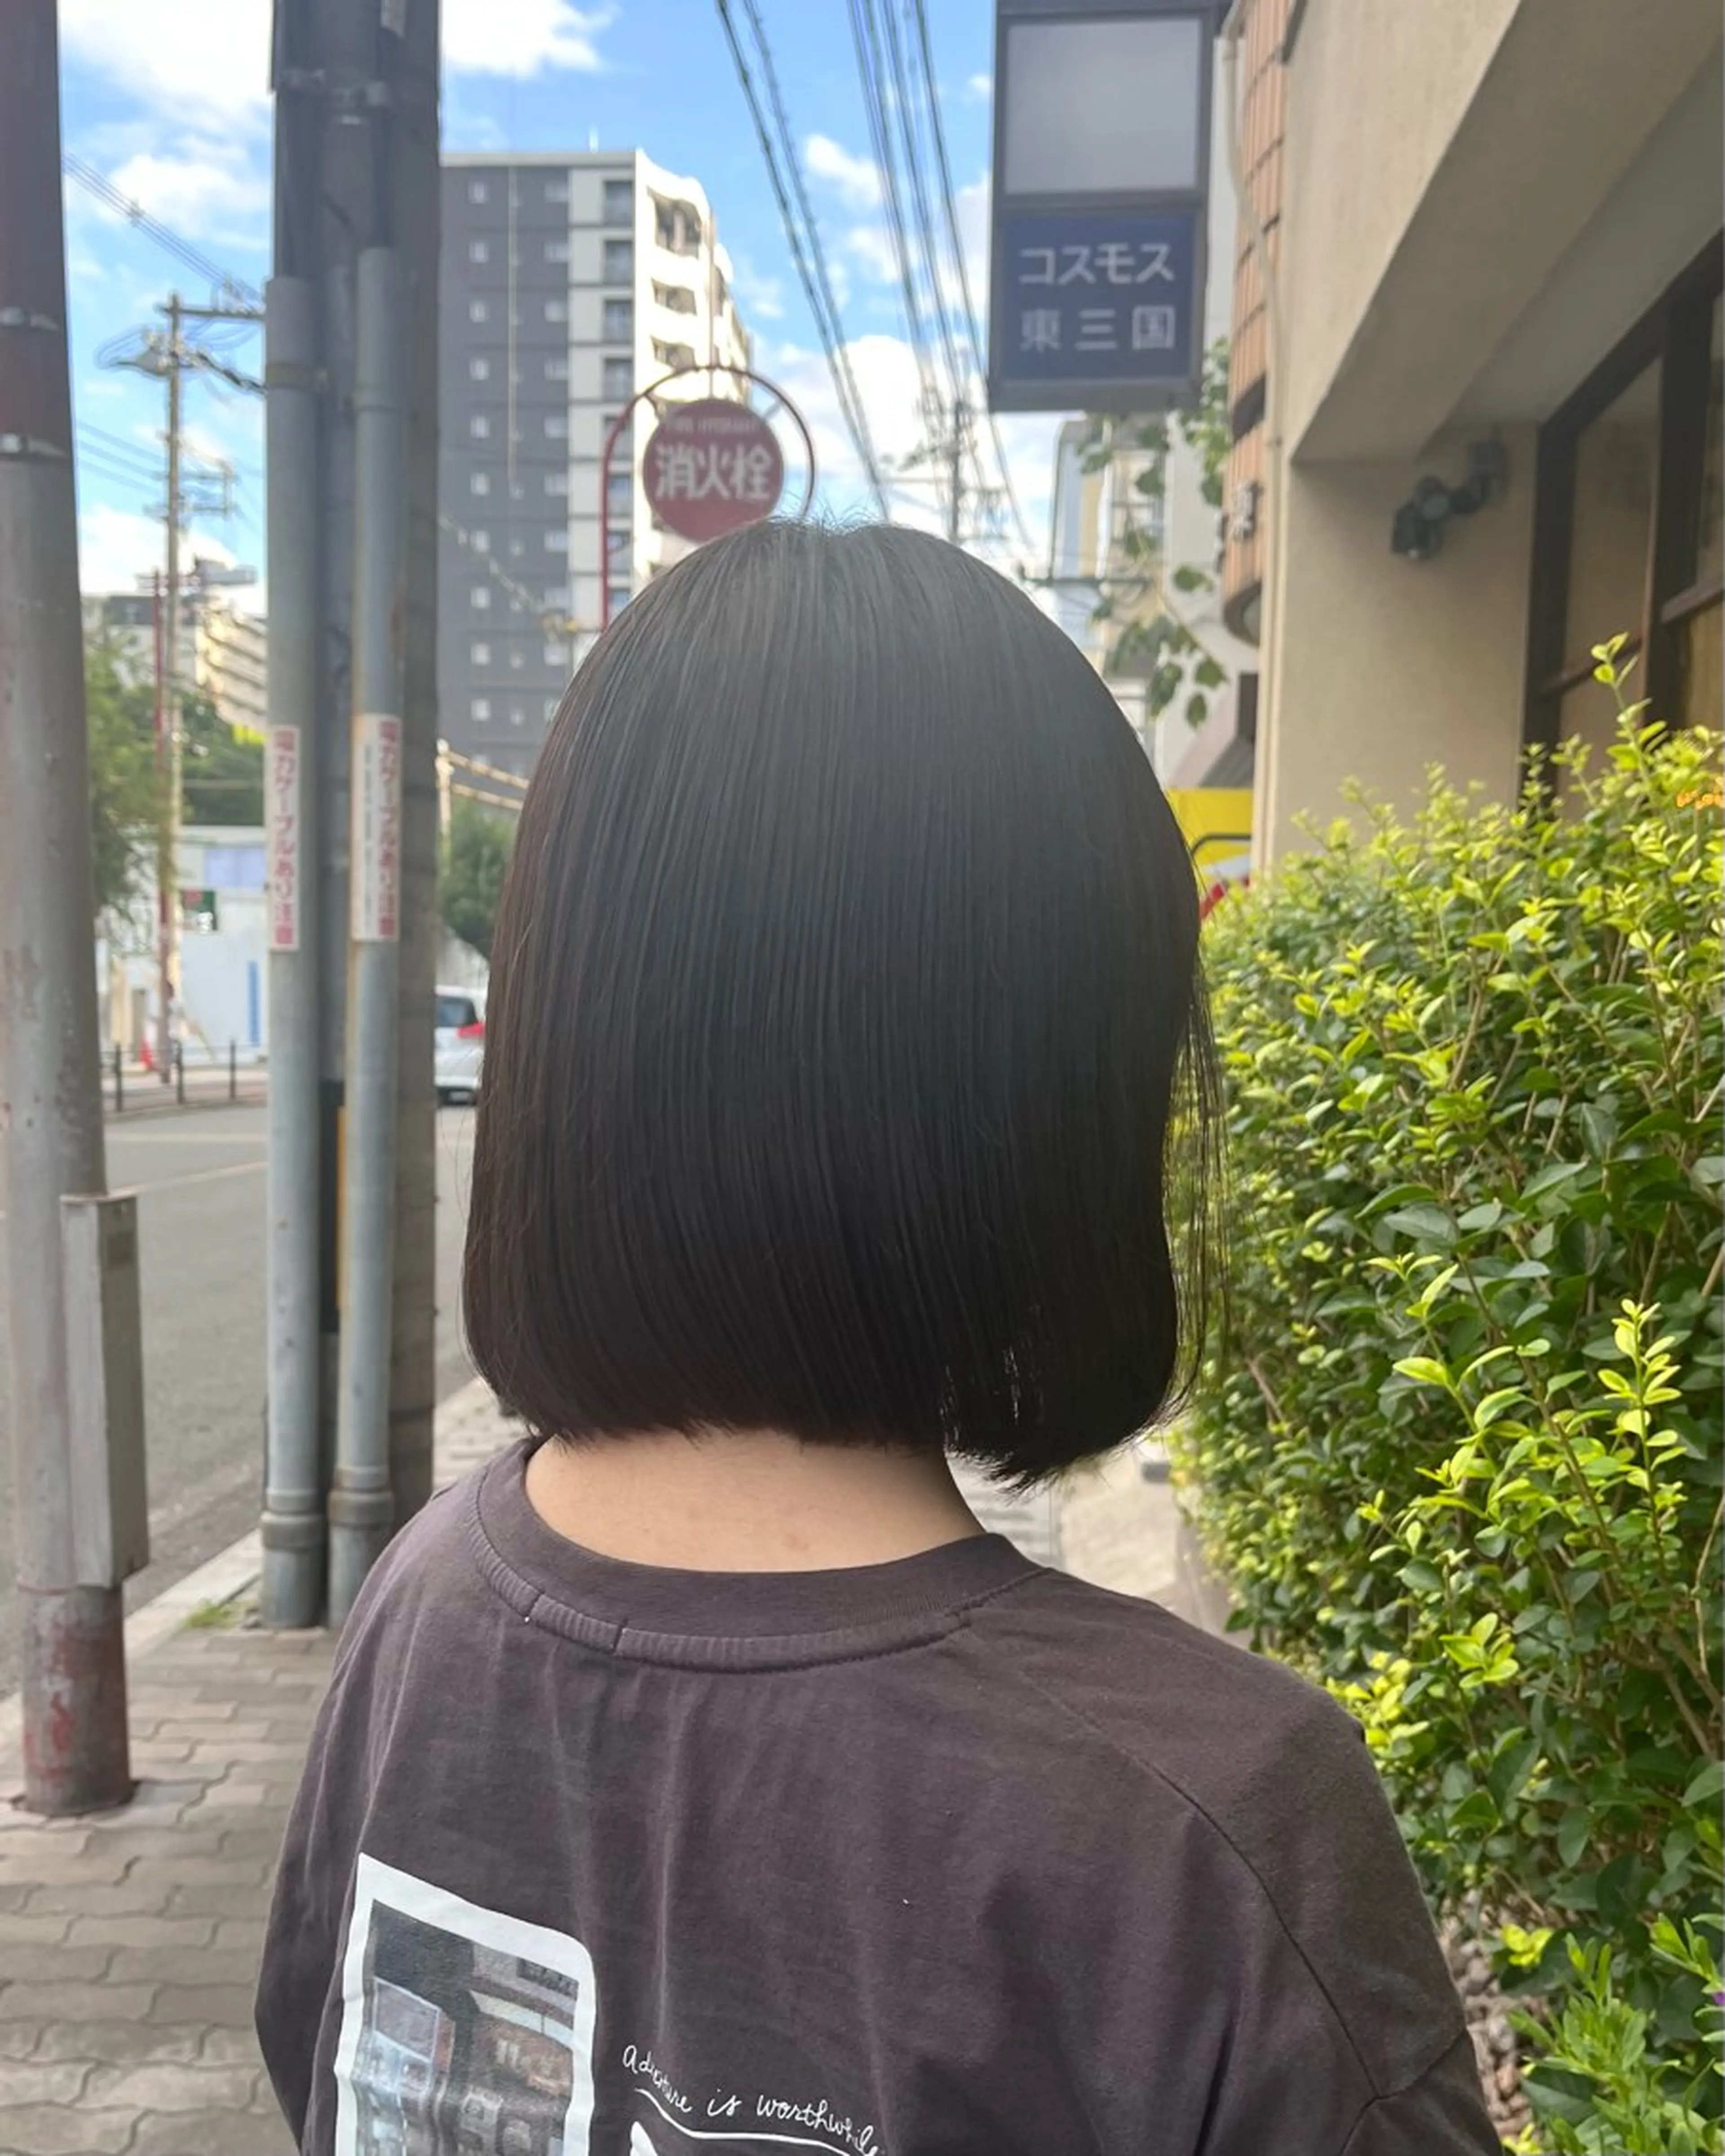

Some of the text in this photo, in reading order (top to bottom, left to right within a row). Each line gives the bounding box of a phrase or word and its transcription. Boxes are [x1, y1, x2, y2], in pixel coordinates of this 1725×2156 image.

[1018, 243, 1175, 286] コスモス
[1020, 305, 1177, 353] 東三国
[654, 442, 773, 500] 消火栓
[707, 2088, 743, 2116] is
